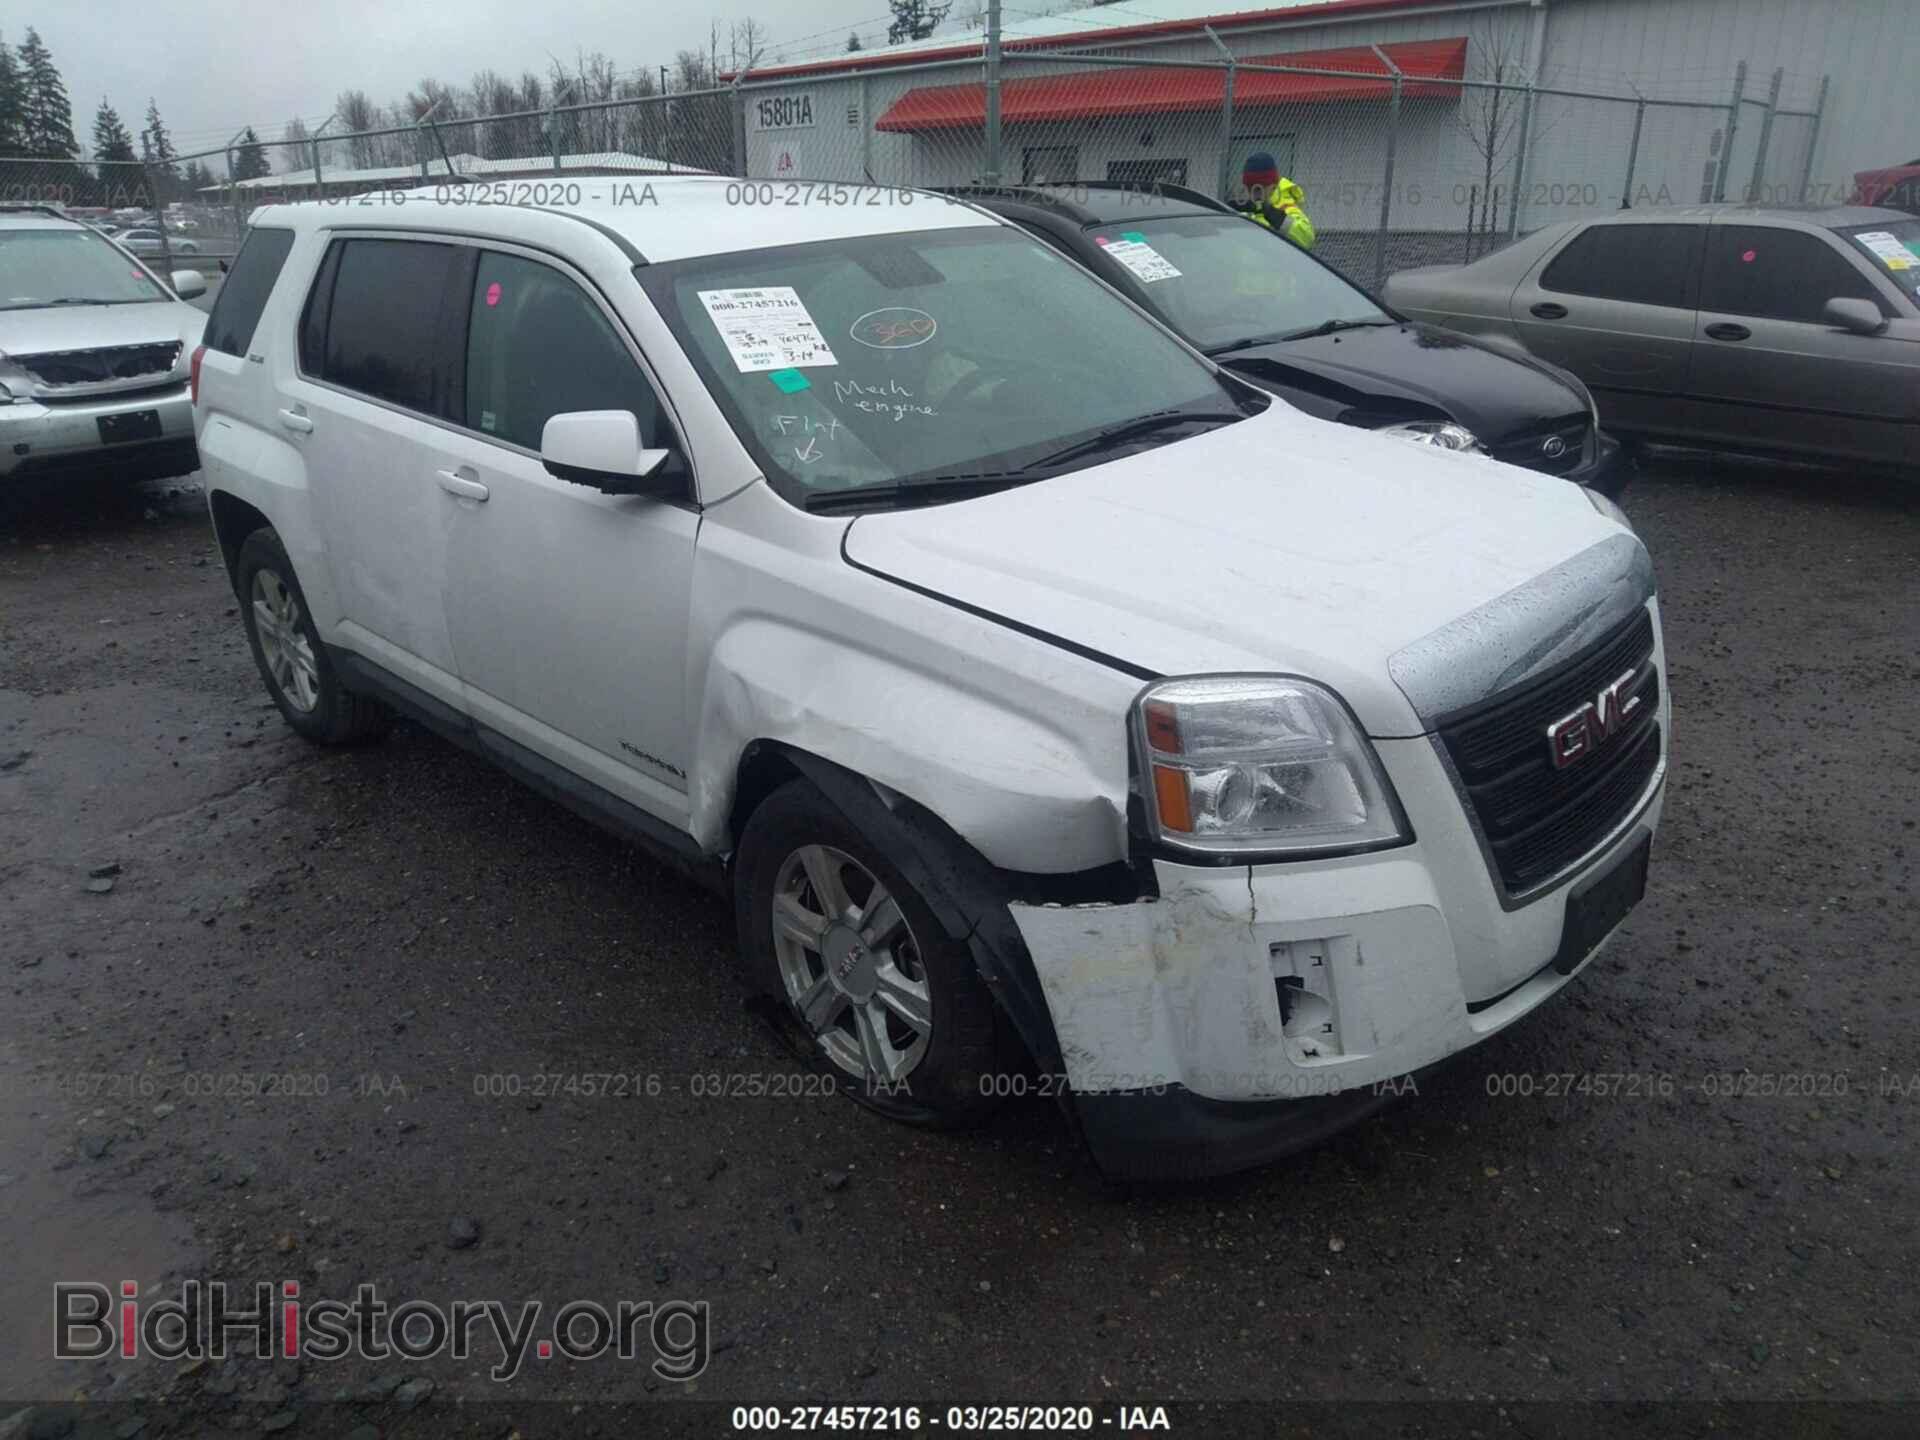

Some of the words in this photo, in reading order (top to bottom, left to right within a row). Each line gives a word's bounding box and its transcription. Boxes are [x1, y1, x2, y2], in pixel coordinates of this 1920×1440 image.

[756, 95, 813, 127] 15801A
[833, 379, 914, 403] Mech
[1547, 668, 1641, 770] GMC
